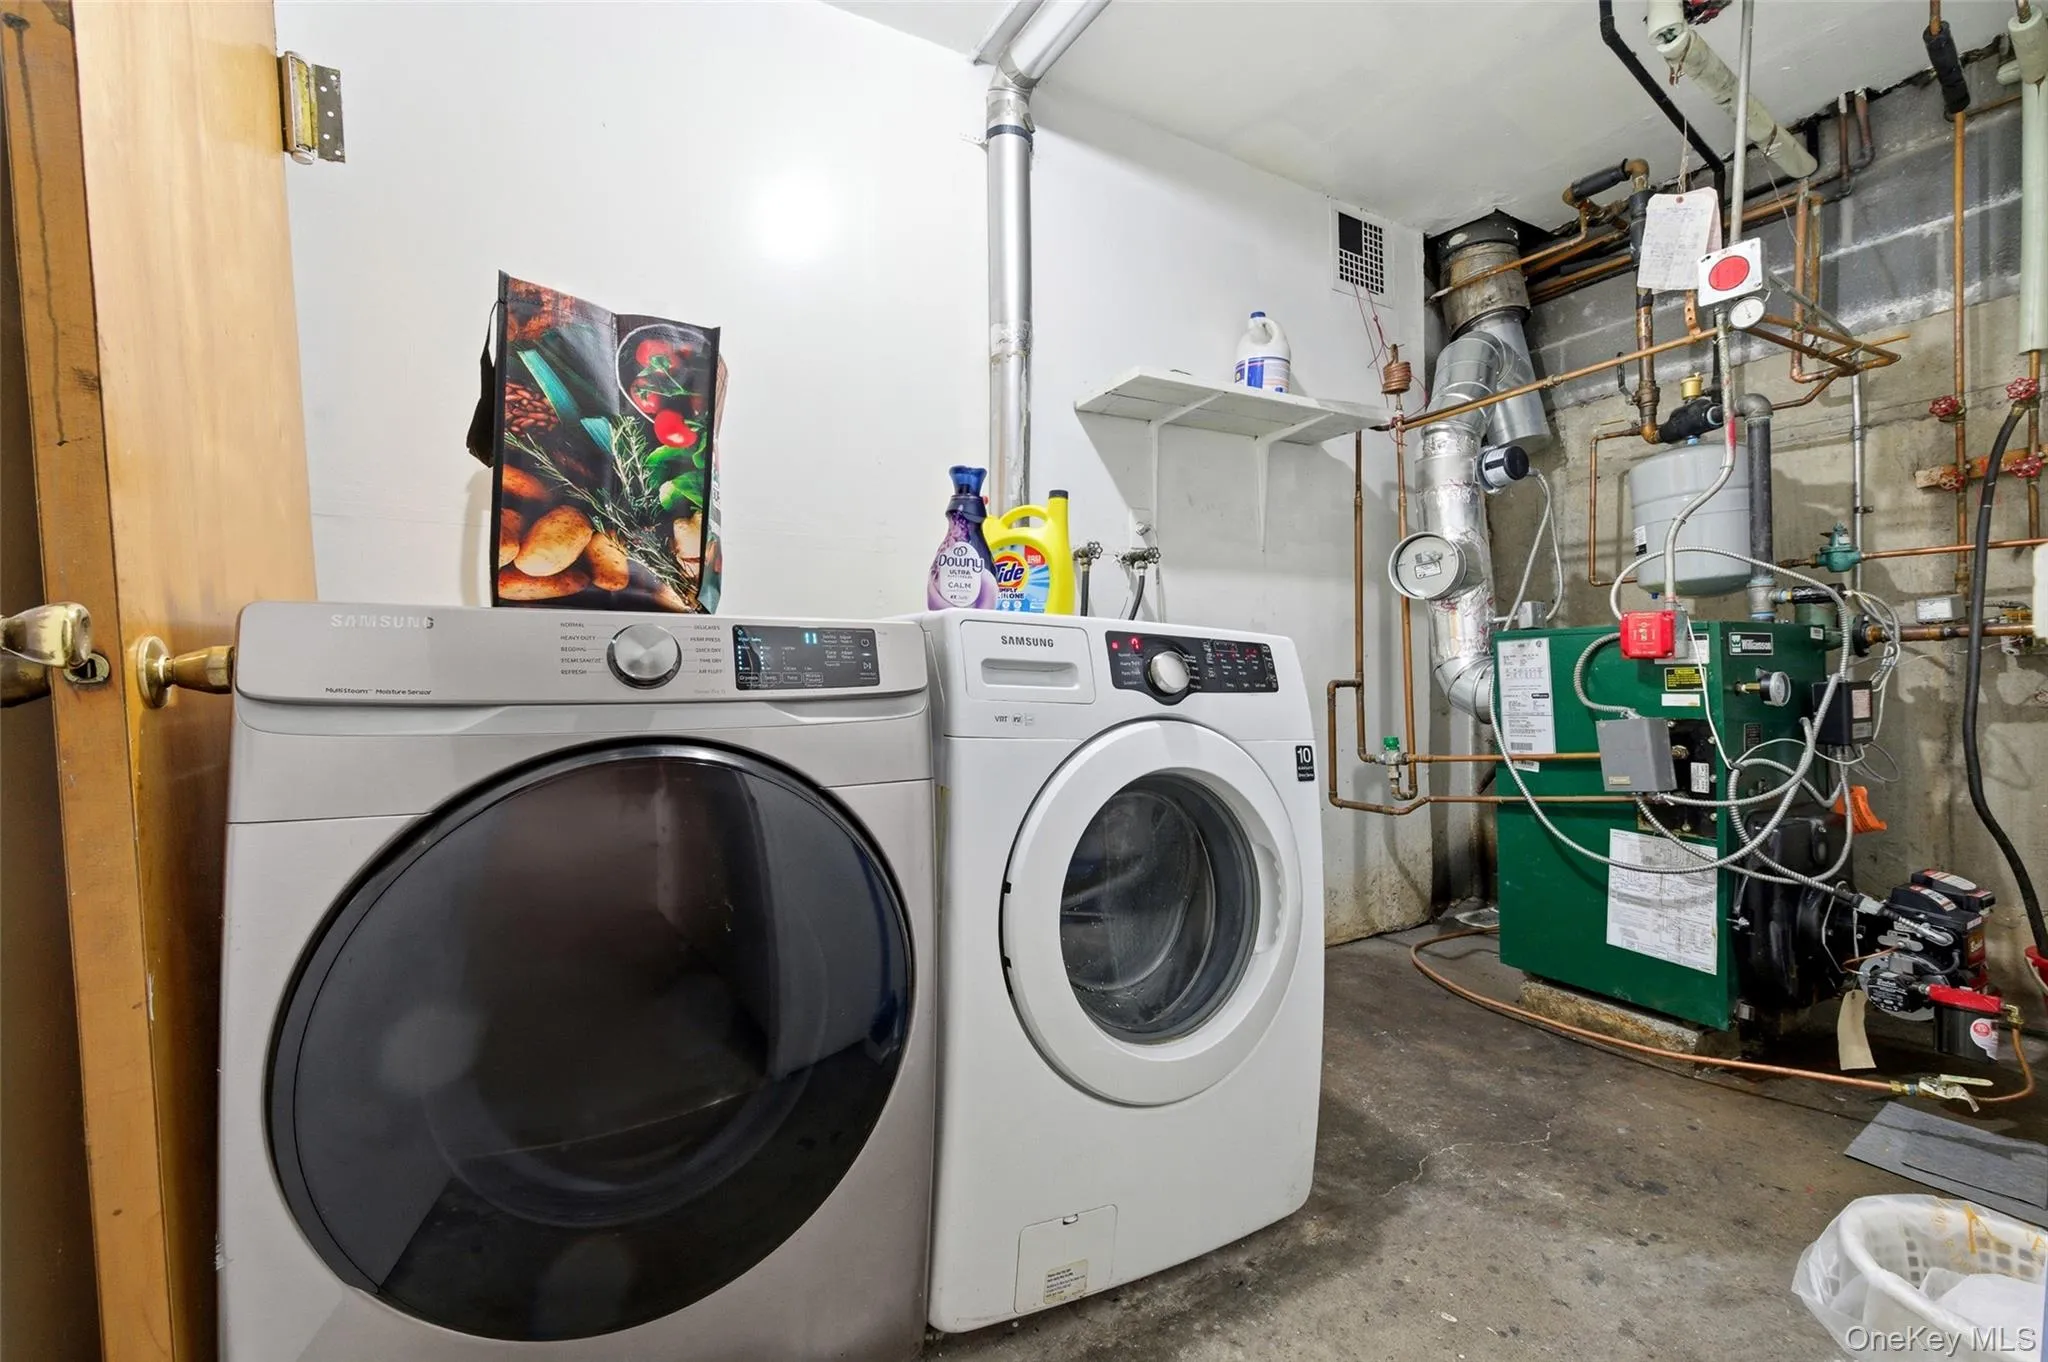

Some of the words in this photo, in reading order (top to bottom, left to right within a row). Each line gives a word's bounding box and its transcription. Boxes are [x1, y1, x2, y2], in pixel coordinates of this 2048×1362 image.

[939, 554, 983, 573] Downy
[996, 562, 1024, 584] Tide
[947, 581, 972, 589] CALM
[330, 613, 435, 630] SAMSUNG
[1001, 635, 1054, 648] SAMSUNG
[375, 688, 407, 696] Moisture
[1297, 747, 1311, 763] 10
